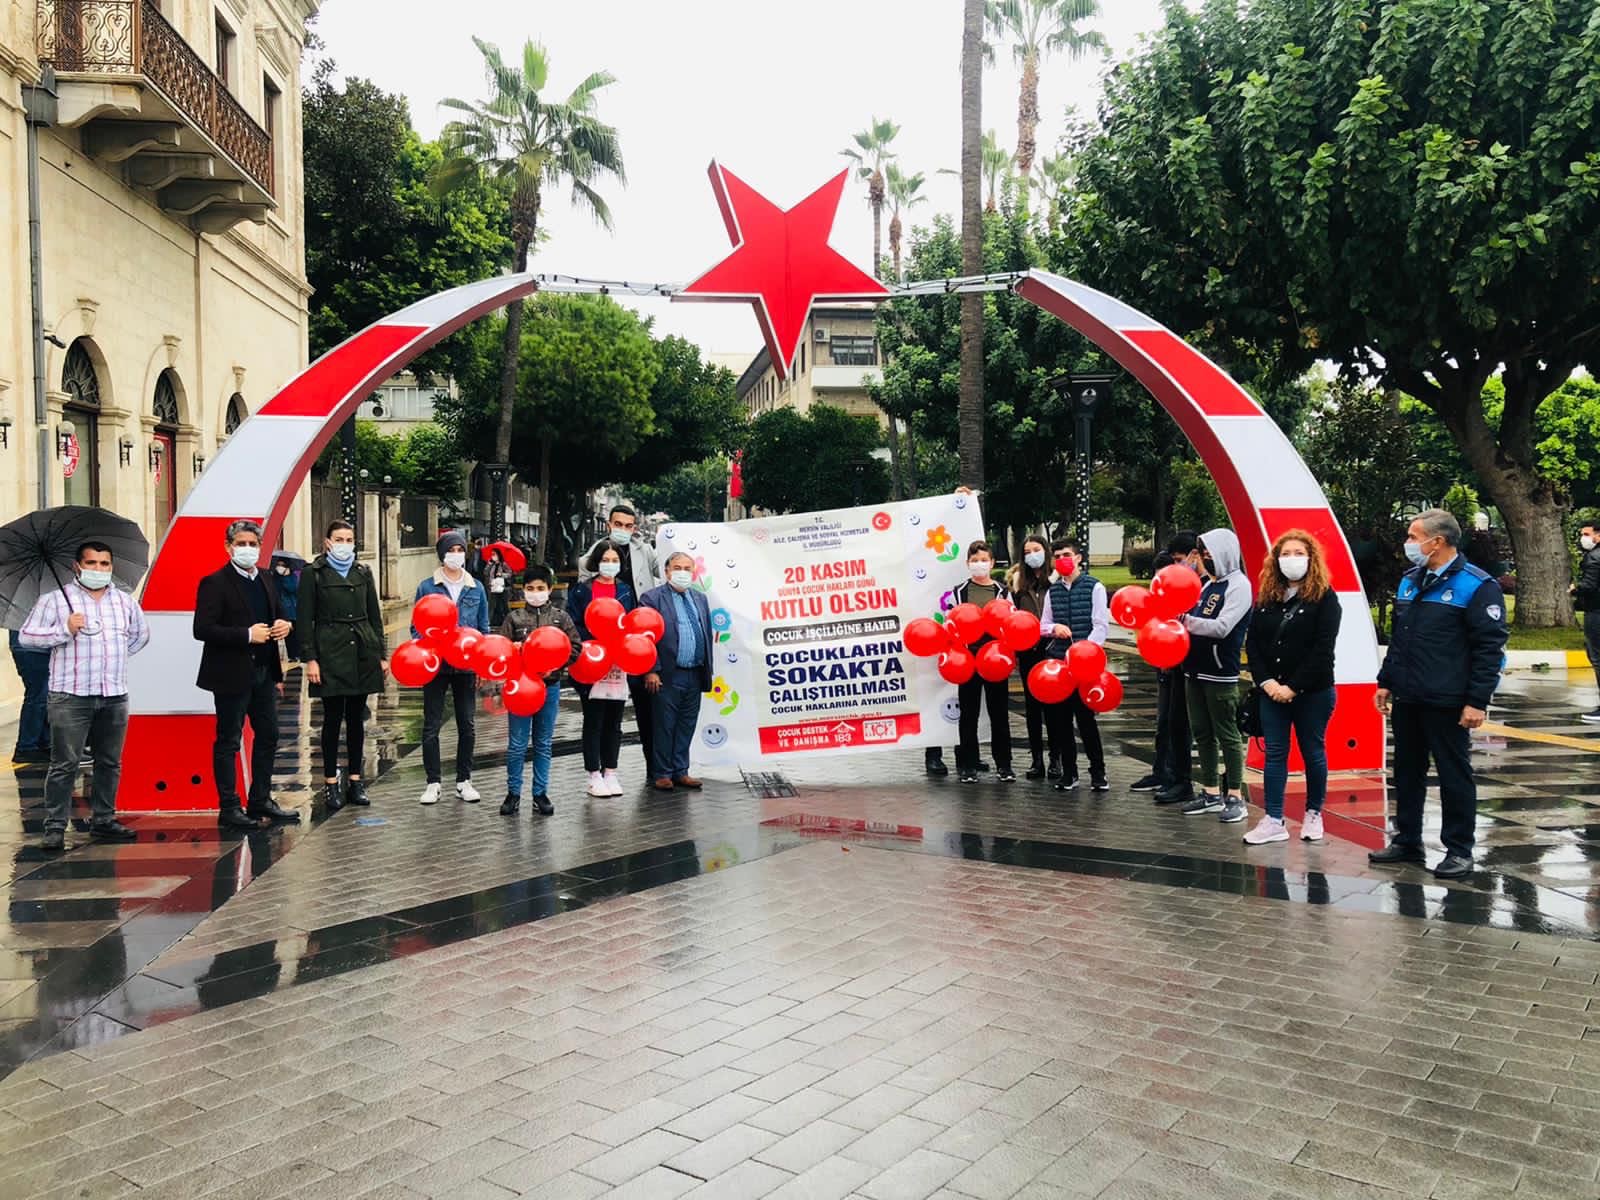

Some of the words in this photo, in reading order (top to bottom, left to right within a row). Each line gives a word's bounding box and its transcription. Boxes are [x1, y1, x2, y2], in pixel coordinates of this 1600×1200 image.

[784, 566, 806, 584] 20
[810, 559, 866, 581] KASIM
[778, 586, 800, 597] DÜNYA
[826, 580, 855, 592] HAKLARI
[856, 576, 876, 589] GÜNÜ
[761, 596, 823, 621] KUTLU
[830, 588, 898, 614] OLSUN
[767, 630, 802, 644] ÇOCUK
[805, 622, 862, 640] İŞÇİLİĞİNE
[864, 619, 897, 632] HAYIR
[765, 640, 903, 667] ÇOCUKLARIN
[768, 657, 904, 686] SOKAKTA
[770, 677, 906, 704] ÇALIŞTIRILMASI
[771, 704, 802, 715] ÇOCUK
[805, 699, 858, 712] HAKLARINA
[860, 694, 906, 706] AYKIRIDIR
[778, 726, 801, 738] ÇOCUK
[802, 724, 828, 734] DESTEK
[778, 738, 789, 748] VE
